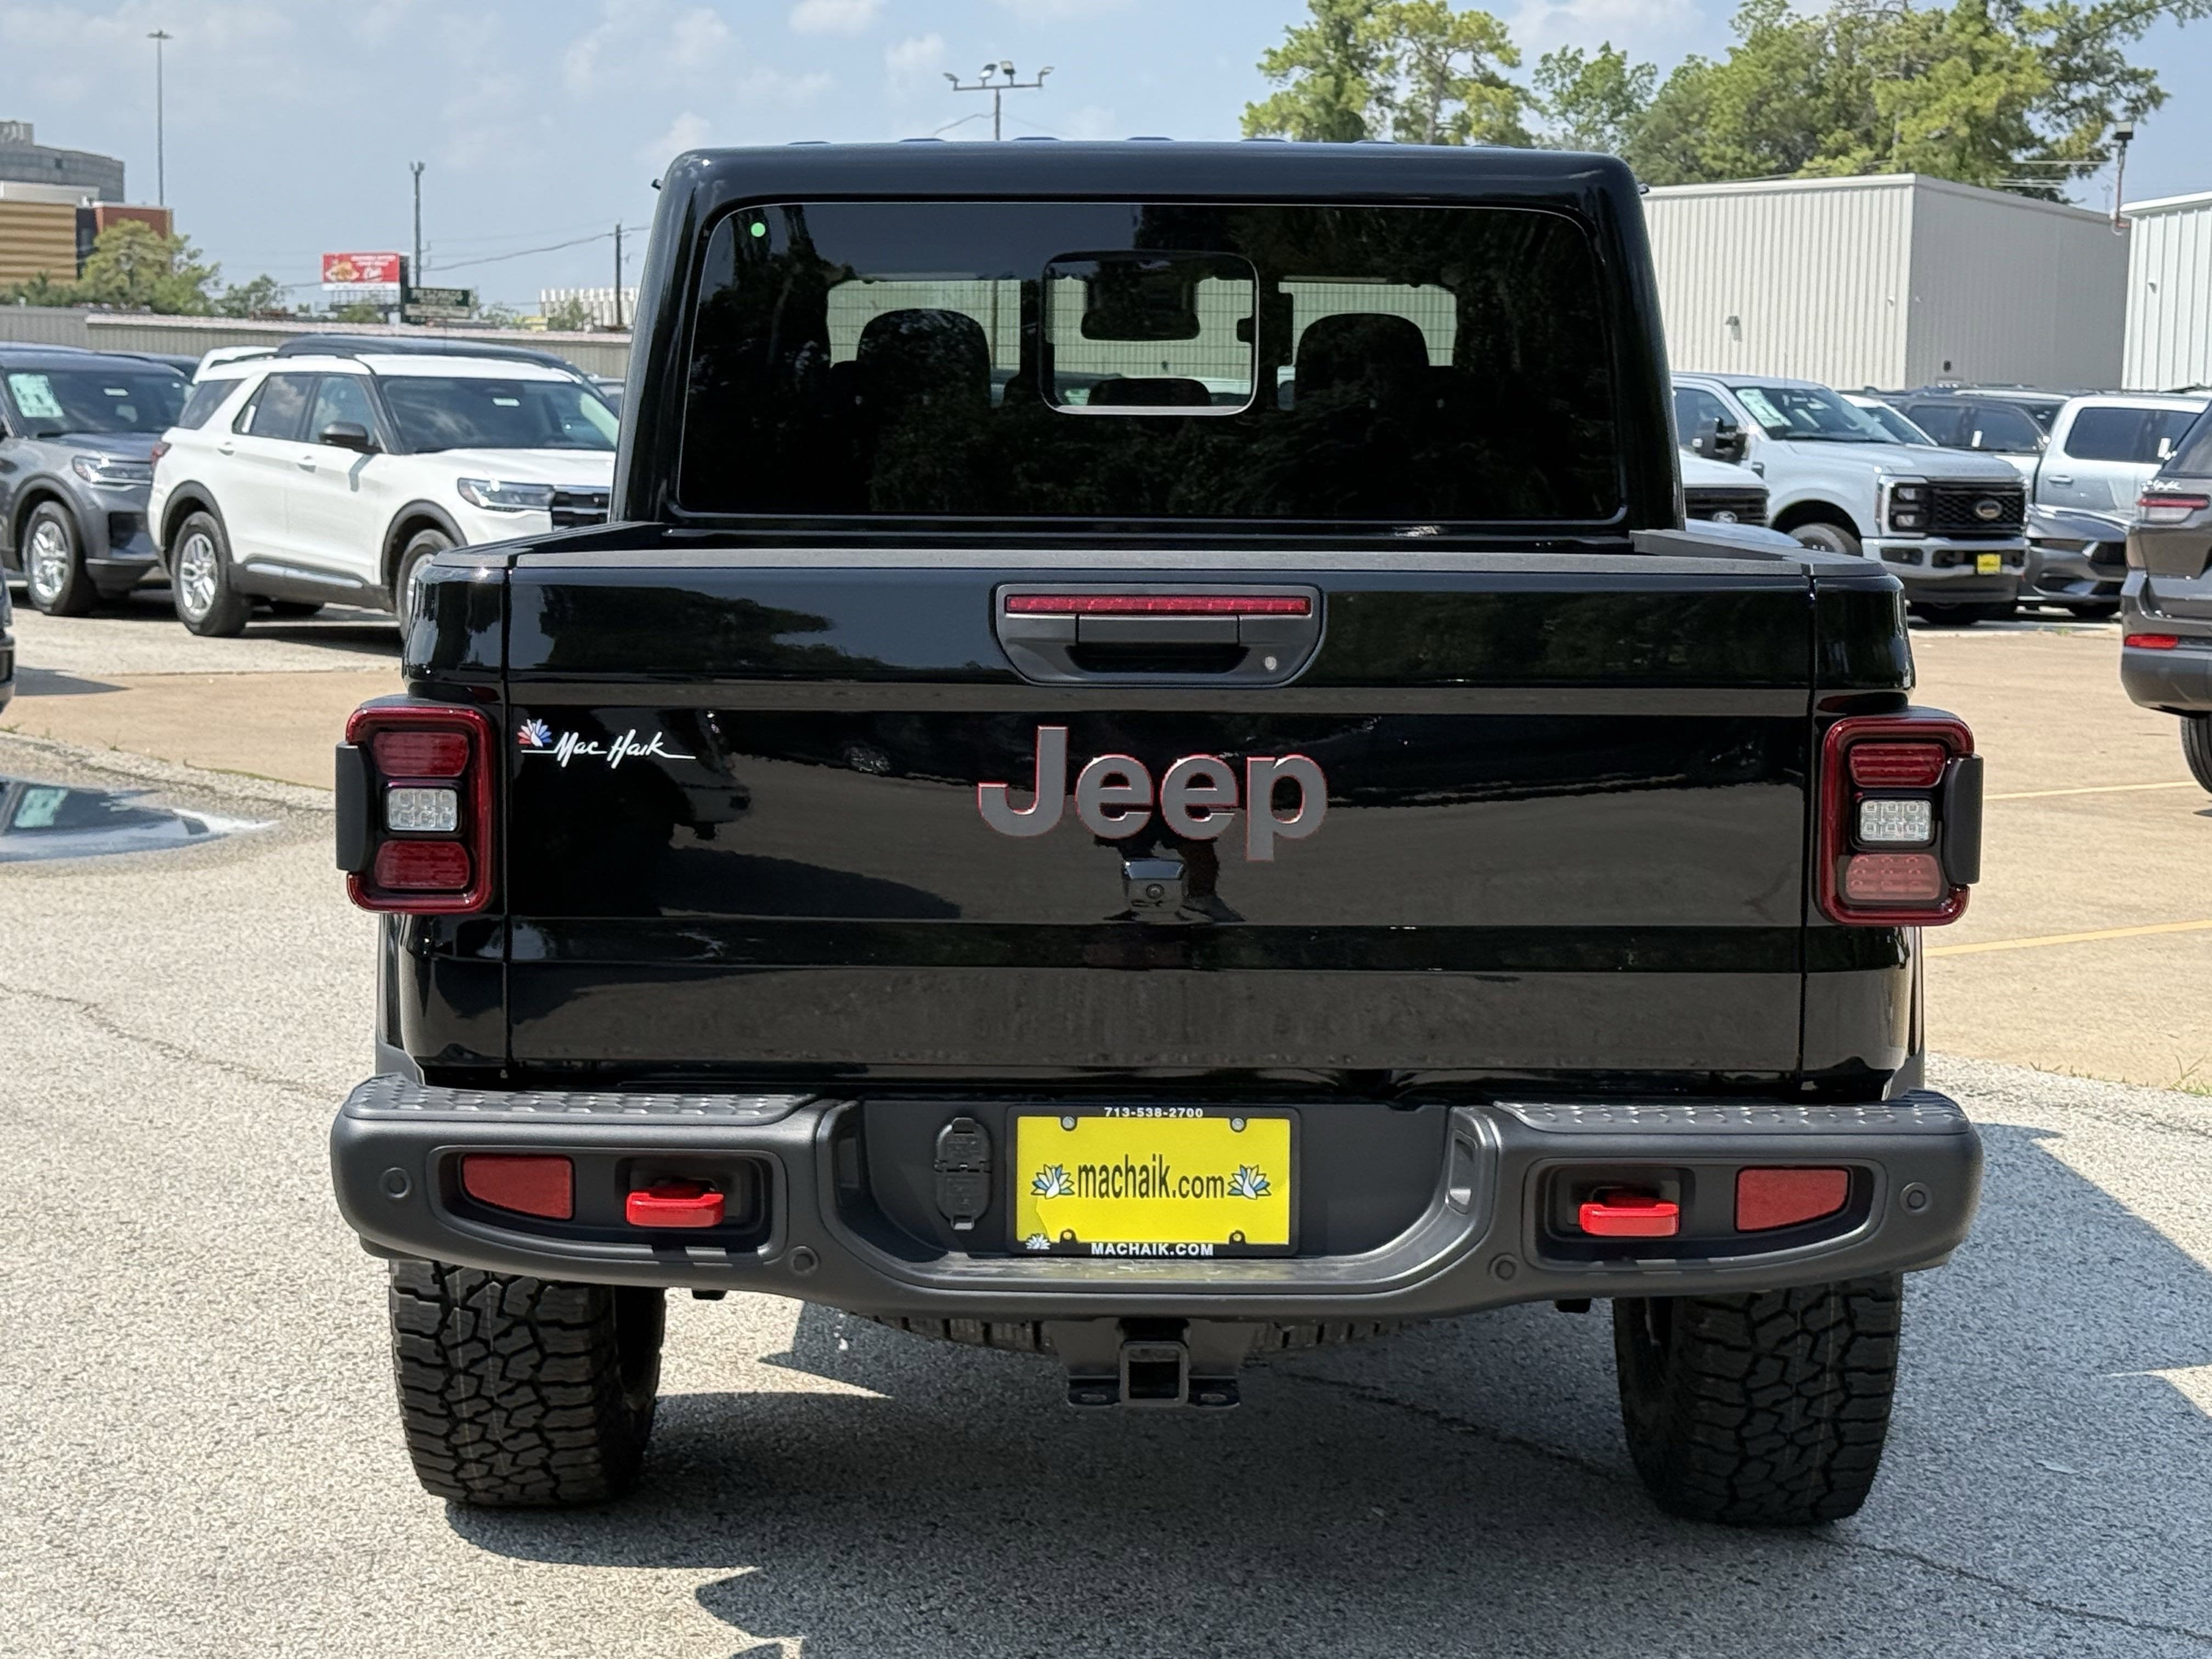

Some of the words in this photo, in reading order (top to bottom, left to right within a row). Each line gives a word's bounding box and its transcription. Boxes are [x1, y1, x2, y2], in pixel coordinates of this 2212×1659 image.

[521, 731, 607, 768] Mac
[606, 729, 696, 769] Haik
[977, 725, 1328, 862] Jeep
[1104, 1107, 1204, 1118] 713-538-2700
[1077, 1153, 1224, 1199] machaik.com
[1091, 1243, 1214, 1256] MACHAIK.COM
